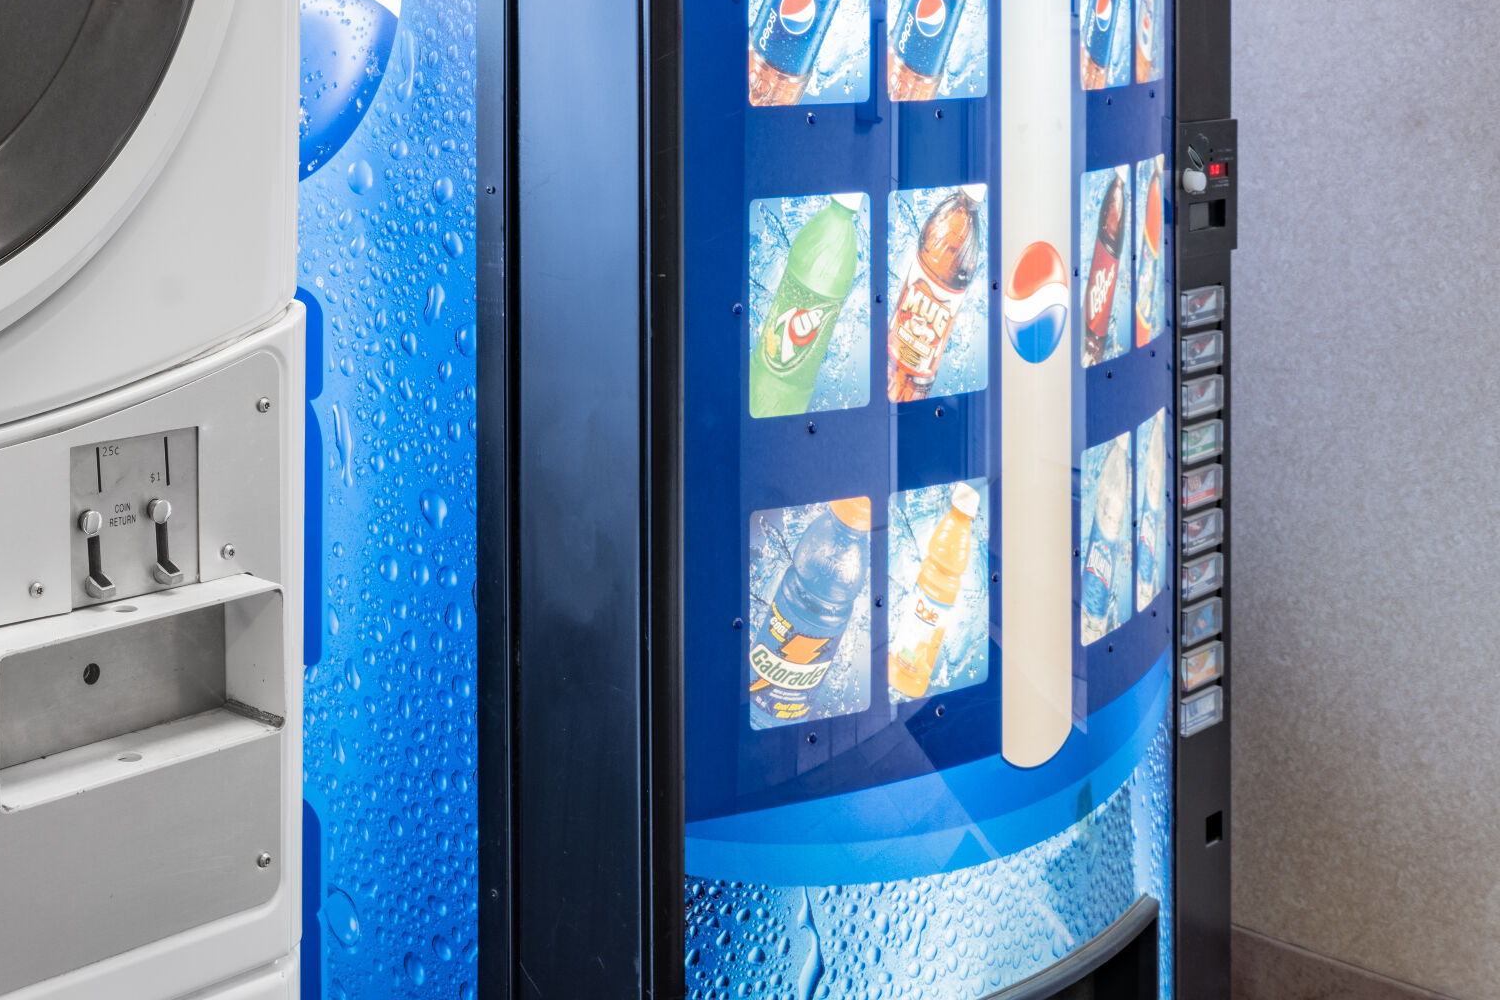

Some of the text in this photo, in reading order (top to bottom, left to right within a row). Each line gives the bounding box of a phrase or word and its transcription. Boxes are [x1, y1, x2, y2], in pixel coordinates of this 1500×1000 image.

[758, 7, 778, 52] pepsi
[898, 11, 914, 55] pepsi
[901, 284, 951, 340] MUG
[150, 472, 161, 484] $1
[109, 514, 137, 528] RETURN
[114, 502, 131, 513] COIN
[751, 648, 827, 687] Gatorade
